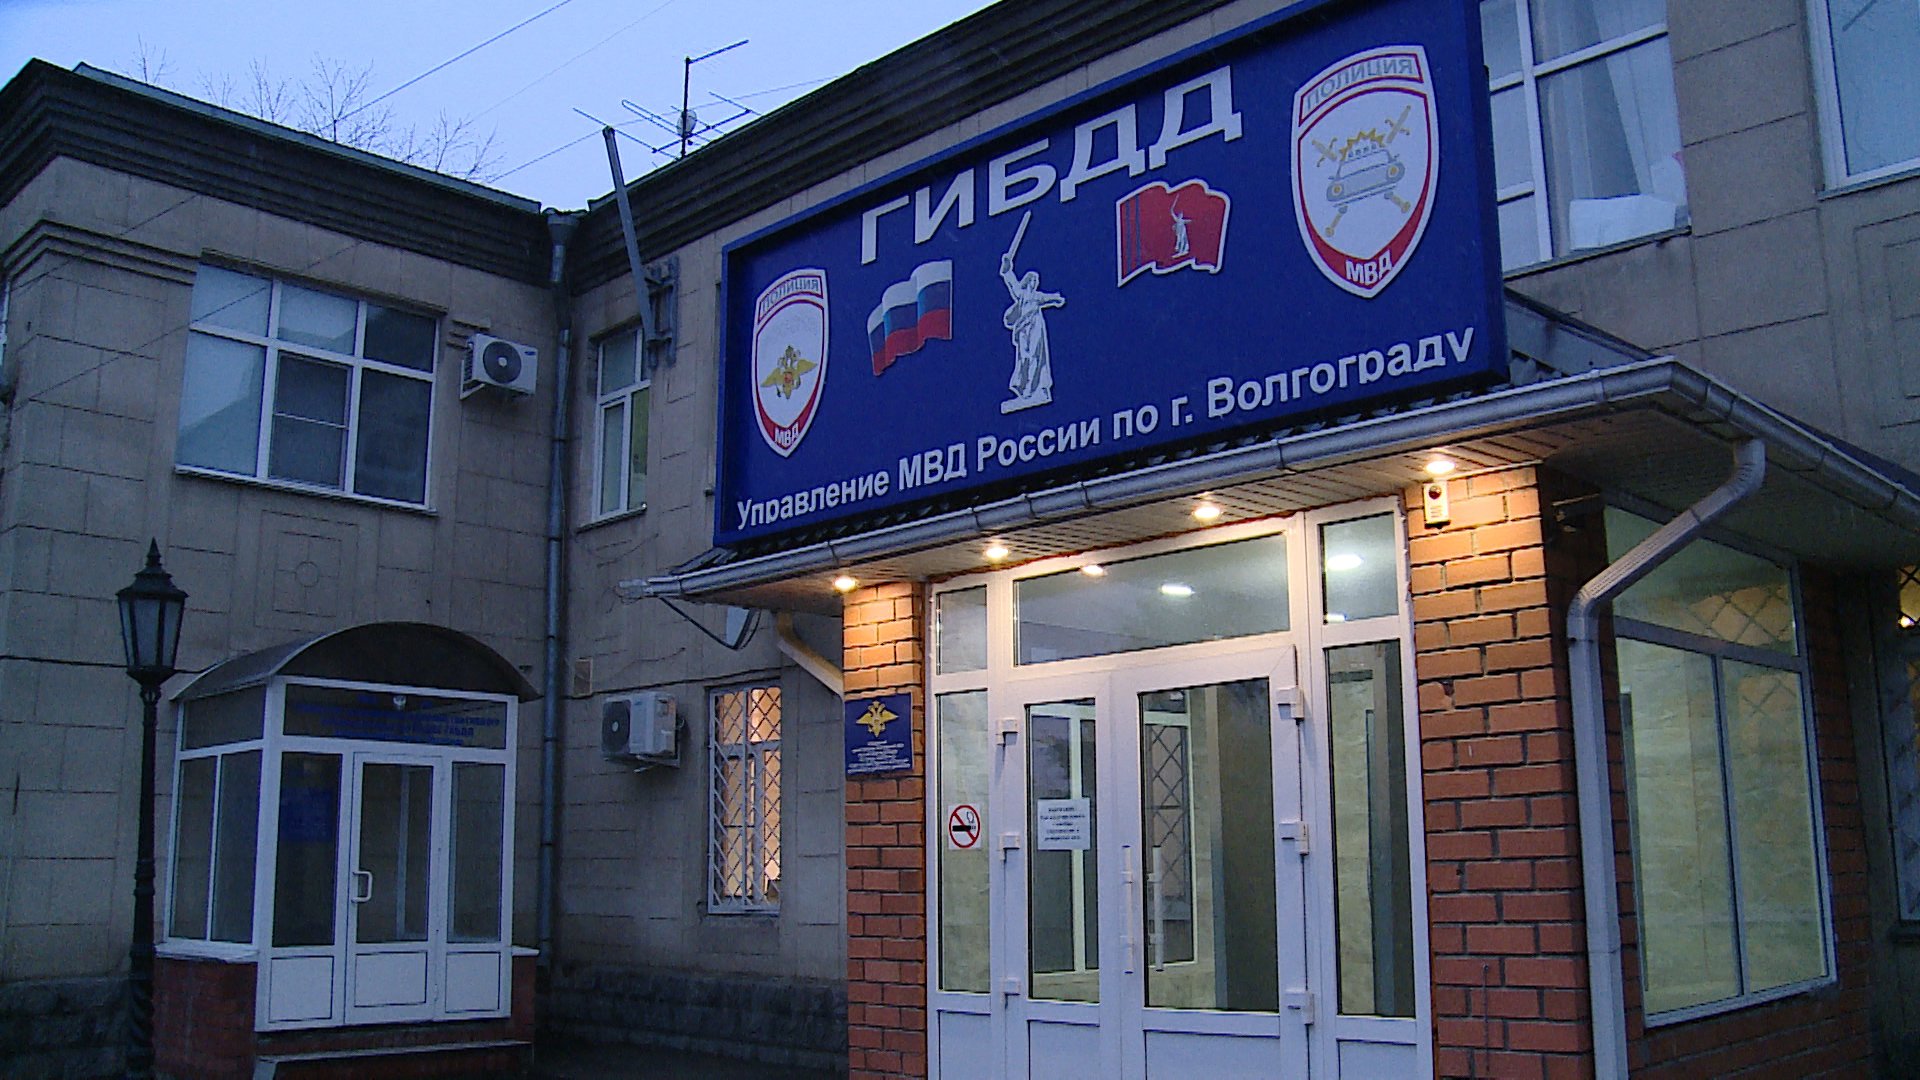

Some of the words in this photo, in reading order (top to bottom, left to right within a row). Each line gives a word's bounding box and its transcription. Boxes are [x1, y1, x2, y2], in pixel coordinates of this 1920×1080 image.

[1305, 58, 1414, 111] ПОЛИЦИЯ
[861, 65, 1243, 266] ГИБДД
[1345, 249, 1393, 286] МВД
[761, 278, 820, 313] ПОЛИЦИЯ
[774, 421, 800, 446] МВД
[736, 471, 890, 530] Управление
[899, 443, 968, 492] МВД
[977, 417, 1100, 473] России
[1113, 404, 1159, 440] по
[1171, 396, 1193, 427] г.
